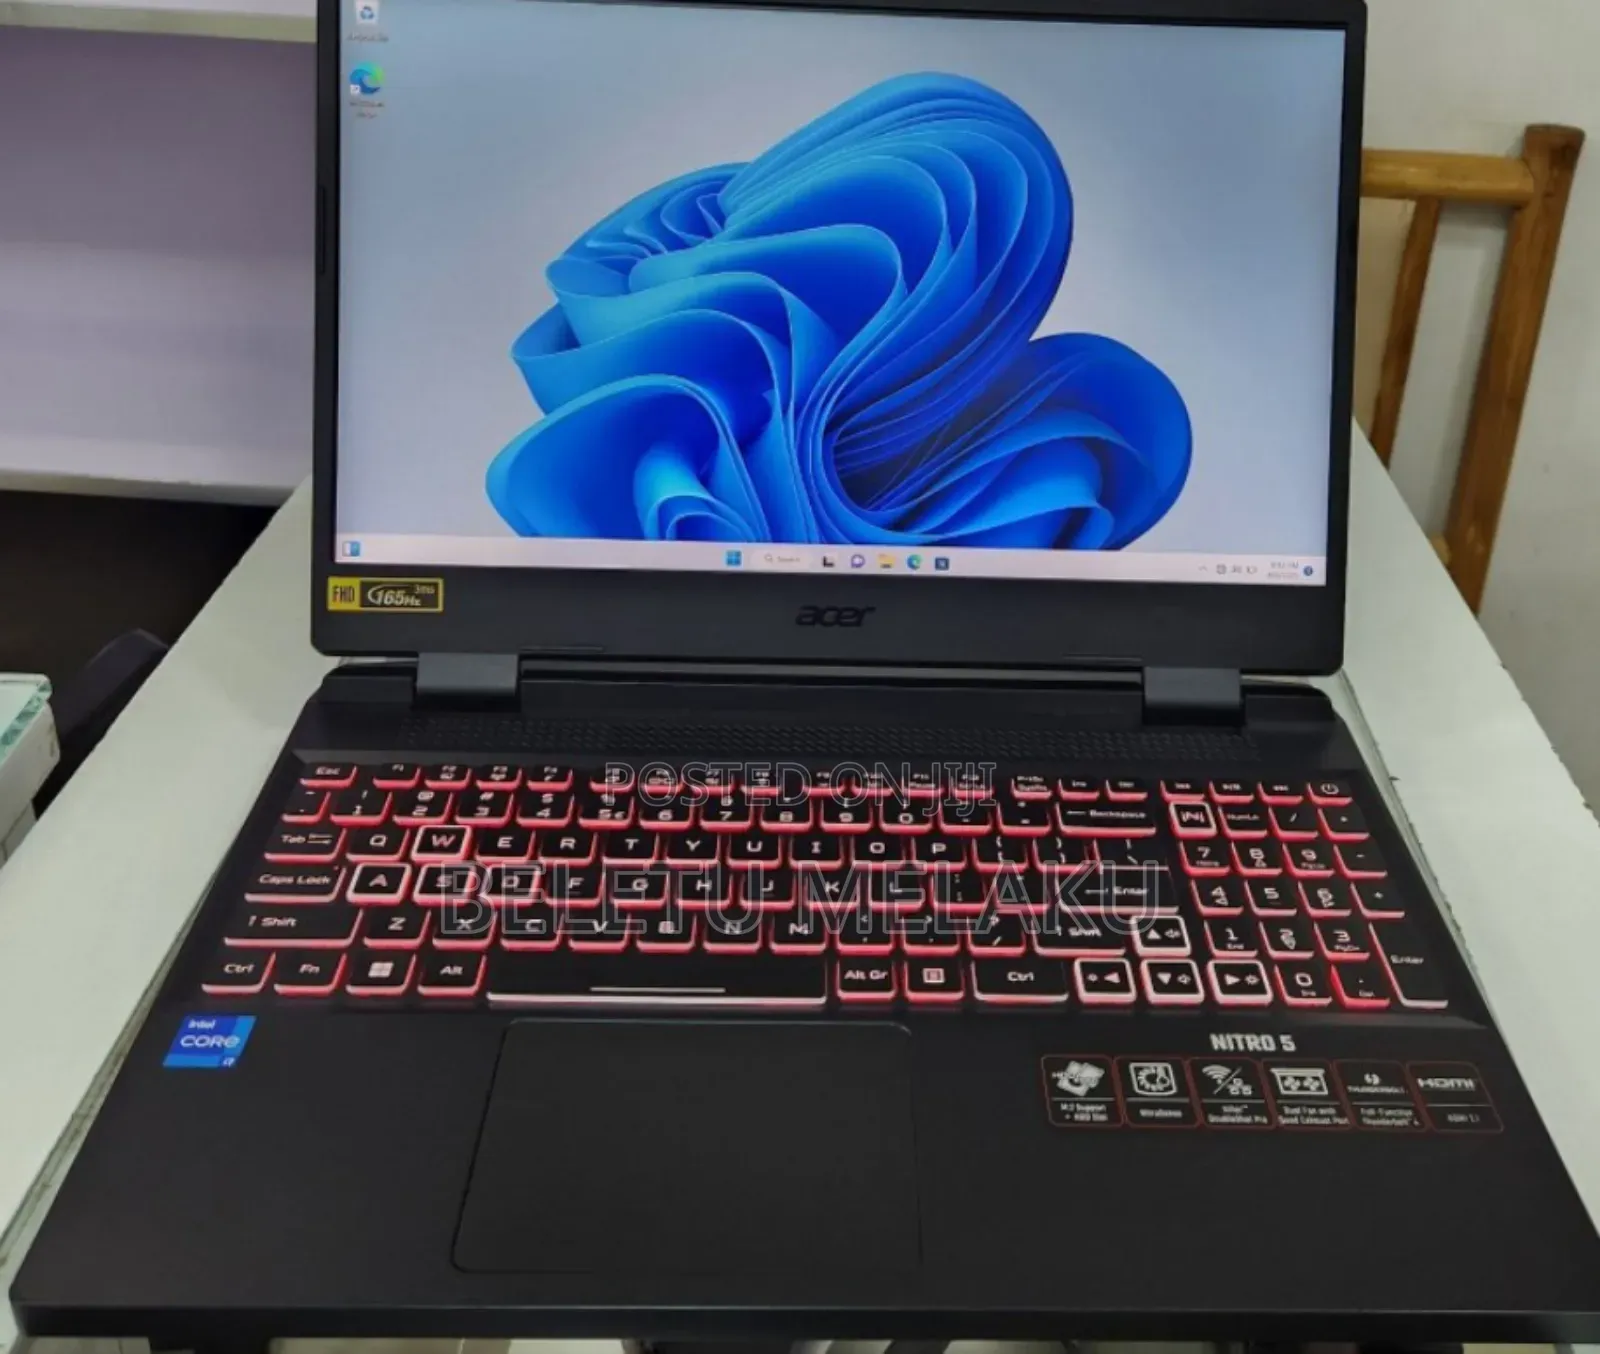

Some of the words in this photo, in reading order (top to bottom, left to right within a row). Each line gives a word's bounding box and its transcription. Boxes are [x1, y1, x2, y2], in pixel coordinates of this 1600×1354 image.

[332, 585, 355, 603] FHD
[375, 589, 422, 607] 165Hz
[795, 604, 876, 628] acer
[315, 766, 340, 776] Esc
[411, 805, 429, 817] 2
[474, 806, 491, 817] 3
[535, 807, 551, 818] 4
[657, 809, 673, 821] 6
[718, 811, 733, 821] 7
[280, 833, 306, 844] Tab
[369, 835, 387, 847] Q
[431, 834, 456, 847] W
[497, 836, 512, 848] E
[560, 837, 577, 849] R
[625, 838, 639, 850] T
[685, 839, 702, 851] Y
[746, 840, 763, 852] U
[811, 841, 822, 853] I
[869, 842, 886, 854] O
[931, 842, 948, 854] P
[1197, 846, 1211, 858] 7
[1248, 847, 1265, 860] 8
[1300, 849, 1317, 861] 9
[259, 874, 292, 886] Caps
[297, 874, 331, 885] Lock
[368, 873, 388, 888] A
[435, 875, 452, 888] S
[501, 875, 520, 888] D
[568, 876, 585, 889] F
[631, 878, 649, 891] G
[695, 879, 713, 892] H
[761, 880, 775, 892] J
[824, 881, 841, 893] K
[889, 882, 903, 894] L
[1112, 885, 1150, 896] Enter
[1263, 887, 1280, 900] 5
[261, 916, 297, 928] Shift
[388, 917, 407, 931] Z
[456, 918, 474, 931] X
[524, 919, 542, 932] C
[591, 920, 609, 934] V
[723, 921, 741, 935] N
[788, 922, 809, 935] M
[1068, 926, 1102, 938] Shift
[1225, 928, 1239, 941] 1
[1332, 929, 1350, 942] 3
[223, 962, 255, 975] Ctrl
[299, 964, 321, 975] Fn
[440, 964, 463, 976] Alt
[844, 967, 866, 980] Alt
[869, 968, 889, 980] Gr
[1007, 970, 1035, 982] Ctrl
[187, 1018, 217, 1030] intel
[1209, 1033, 1276, 1052] NITRO
[1279, 1034, 1297, 1052] 5
[1417, 1077, 1476, 1091] HDMI
